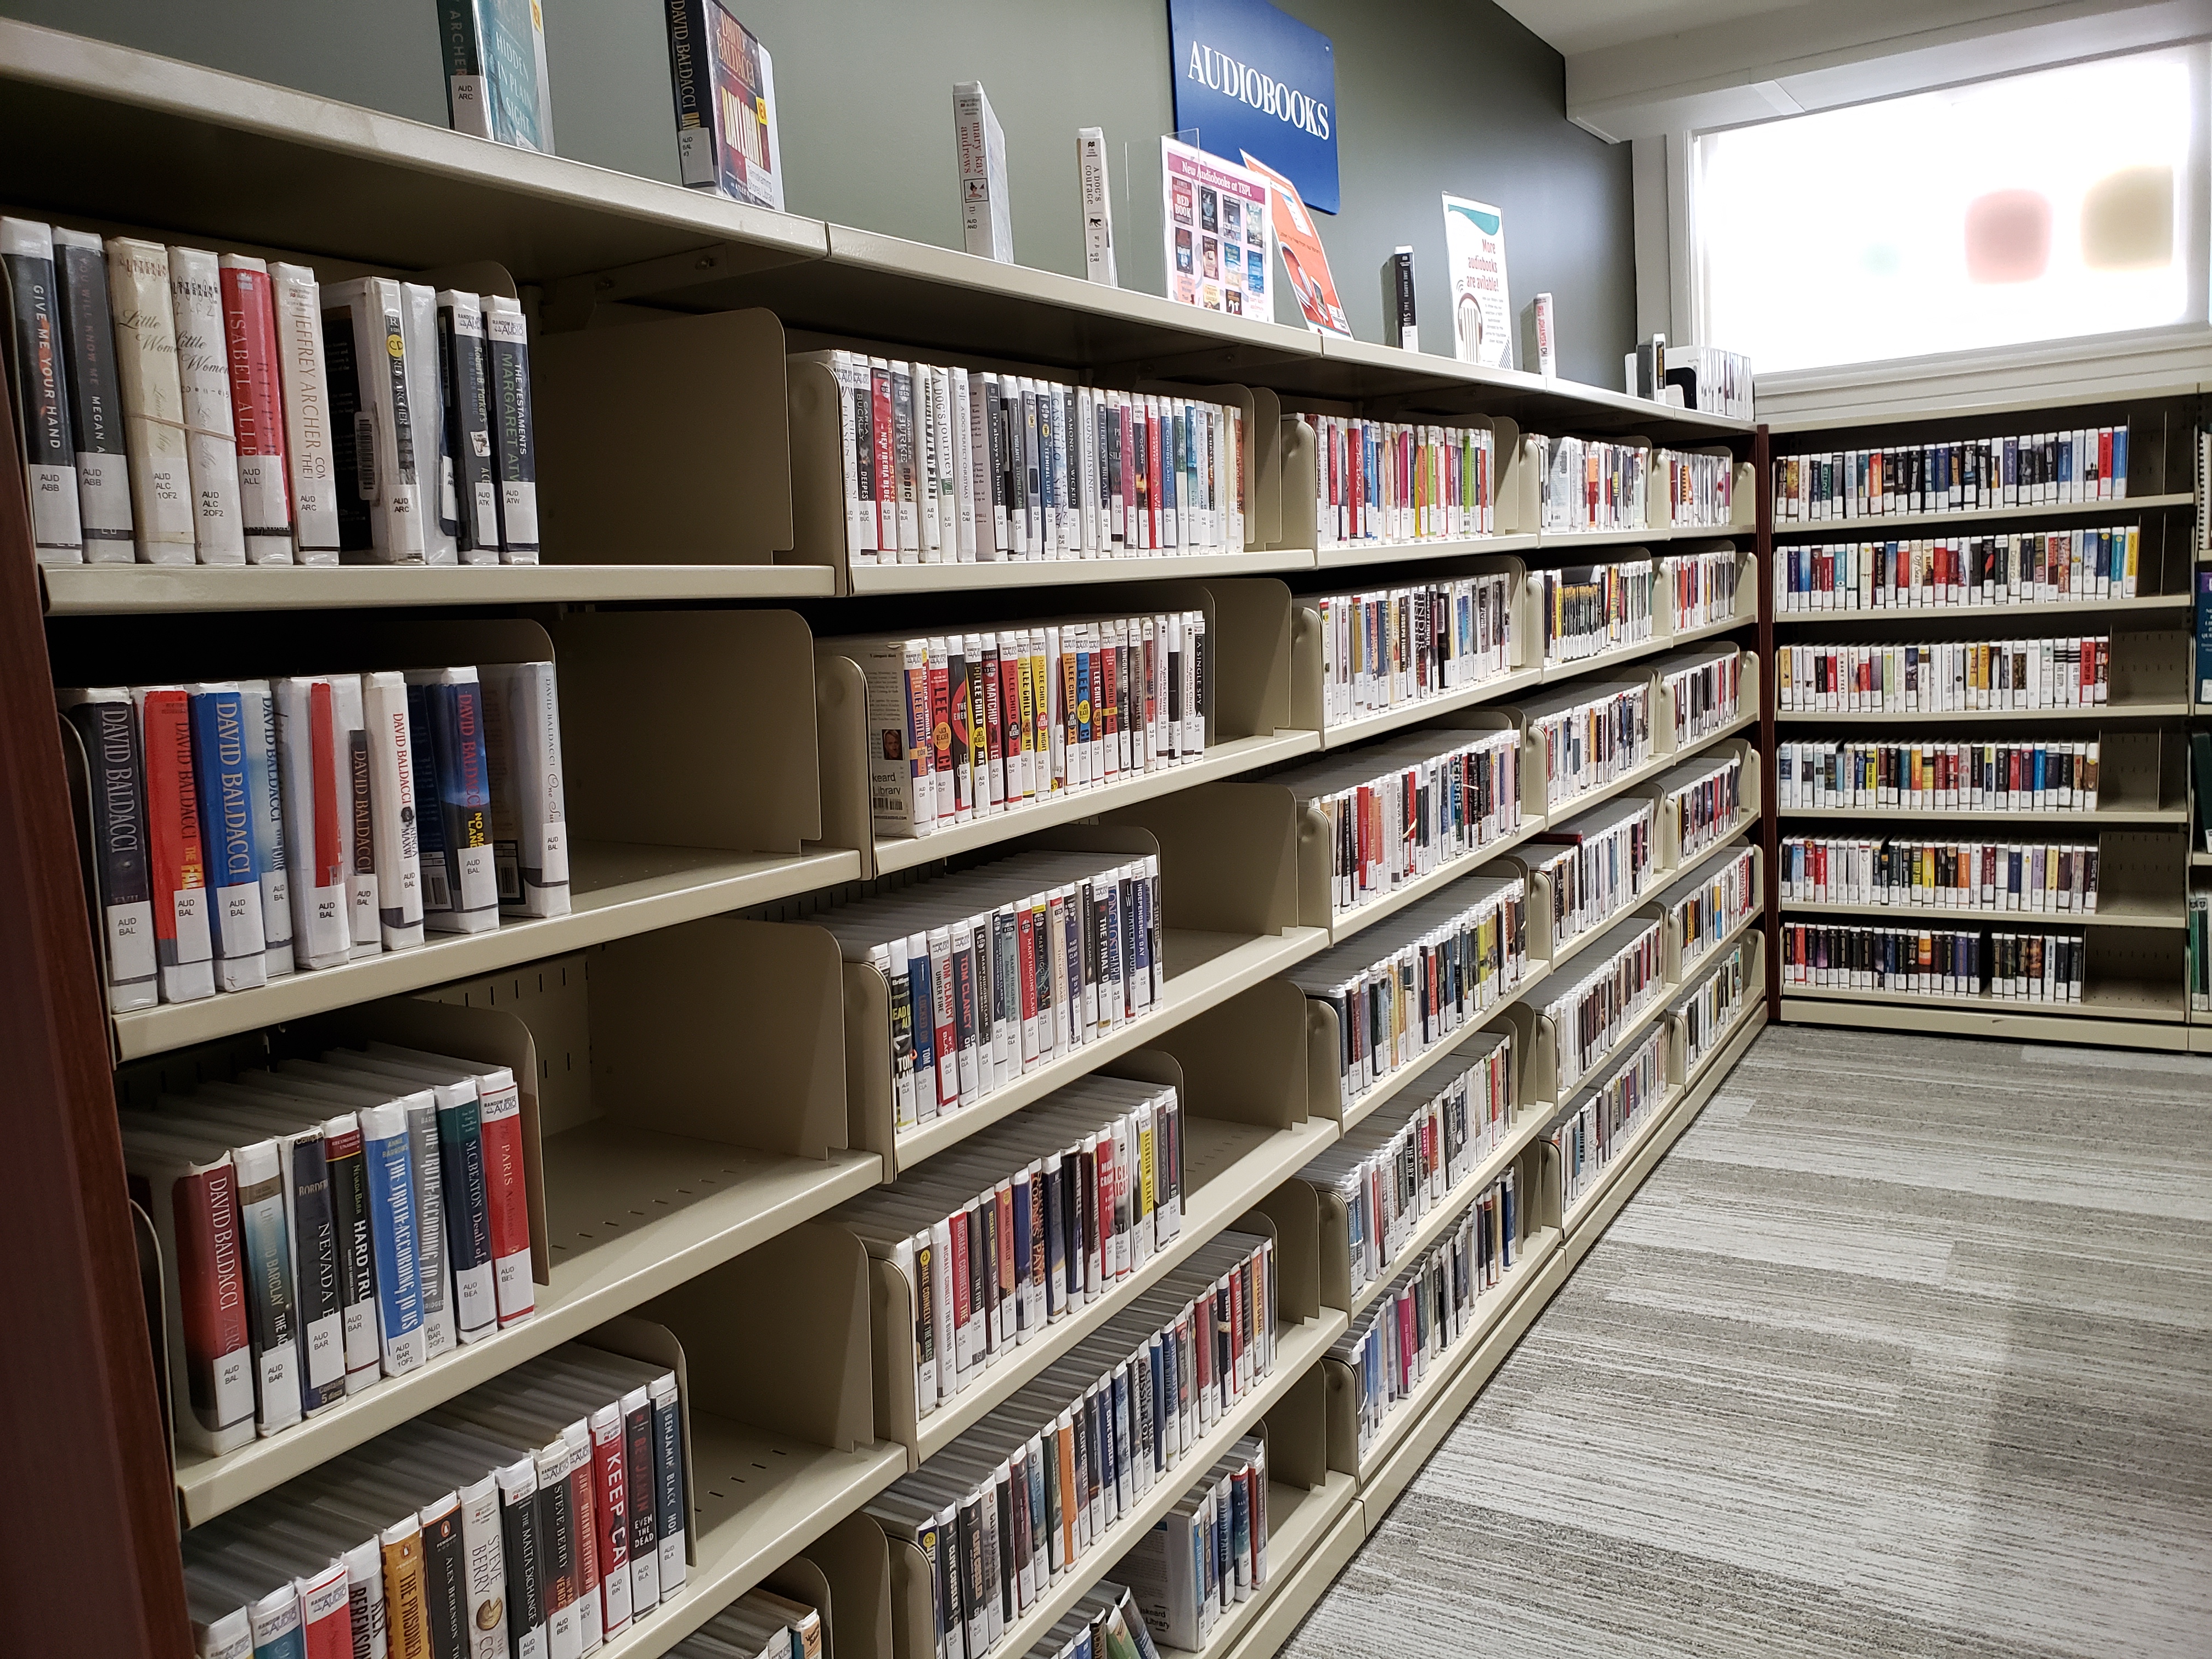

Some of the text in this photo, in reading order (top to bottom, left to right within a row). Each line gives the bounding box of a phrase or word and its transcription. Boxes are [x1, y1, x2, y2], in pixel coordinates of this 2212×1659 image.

[496, 31, 528, 81] HIDDEN
[671, 1, 696, 108] DAVID BALDACCI
[716, 31, 755, 89] BALDACCI
[498, 61, 532, 110] IN PLAIN
[1188, 41, 1329, 140] AUDIOBOOKS
[506, 97, 530, 133] SIGHT
[961, 126, 971, 173] andrews
[972, 121, 985, 176] mary kay
[1176, 193, 1189, 207] RED
[1182, 160, 1196, 177] New
[1198, 167, 1231, 189] Audiobooks
[1231, 180, 1237, 191] at
[1238, 182, 1252, 197] TSPL
[1175, 204, 1192, 218] BOOK
[1468, 256, 1498, 273] audiobooks
[1482, 239, 1496, 254] More
[1467, 276, 1476, 288] are
[118, 309, 161, 330] Little
[176, 331, 207, 349] Little
[502, 326, 524, 335] AUDIO
[33, 285, 61, 448] GIVE ME YOUR HAND
[230, 310, 251, 390] ISABEL
[289, 315, 316, 377] JEFFREY
[389, 340, 403, 350] CD
[474, 346, 483, 376] Robert
[92, 395, 105, 440] MEGAN
[301, 382, 321, 449] ARCHER
[395, 381, 408, 425] ARCHER
[477, 387, 487, 422] Parker's
[501, 353, 518, 447] MARGARET
[515, 386, 527, 455] TESTAMENTS
[899, 414, 907, 462] BURKE
[302, 453, 313, 473] THE
[934, 687, 947, 716] LEE
[986, 682, 998, 725] MATCHUP
[393, 713, 411, 804] DAVID BALDACCI
[459, 695, 481, 809] DAVID BALDACCI
[100, 709, 138, 854] DAVID BALDACCI
[175, 722, 197, 840] DAVID BALDACCI
[216, 702, 251, 874] DAVID BALDACCI
[266, 748, 281, 823] BALDACCI
[548, 773, 560, 800] One
[873, 786, 901, 795] Library
[354, 750, 372, 873] DAVID BALDACCI
[475, 812, 482, 829] NO
[117, 917, 137, 927] AUD
[229, 899, 246, 907] AUD
[230, 907, 246, 917] BAL
[119, 926, 136, 936] BAL
[943, 957, 953, 1019] TOM CLANCY
[501, 1144, 512, 1186] PARIS
[209, 1176, 238, 1311] DAVID BALDACCI
[353, 1219, 369, 1267] HARD
[472, 1212, 485, 1246] Death
[318, 1222, 334, 1304] NEVADA
[475, 1247, 486, 1260] of
[266, 1259, 285, 1306] BARCLAY
[463, 1282, 477, 1290] AUD
[663, 1413, 676, 1507] BENJAMIN BLACK
[607, 1451, 624, 1522] KEEP
[554, 1485, 568, 1569] STEVE BERRY
[634, 1513, 653, 1529] EVEN
[635, 1533, 654, 1548] DEAD
[637, 1525, 651, 1537] THE
[472, 1544, 490, 1595] BERRY
[488, 1534, 501, 1585] STEVE
[522, 1528, 534, 1567] MALTA
[446, 1557, 458, 1639] ALEX BERENSON
[525, 1565, 537, 1621] EXCHANGE
[948, 1544, 958, 1611] CLIVE CUSSLER
[399, 1570, 421, 1659] THE PRISONER
